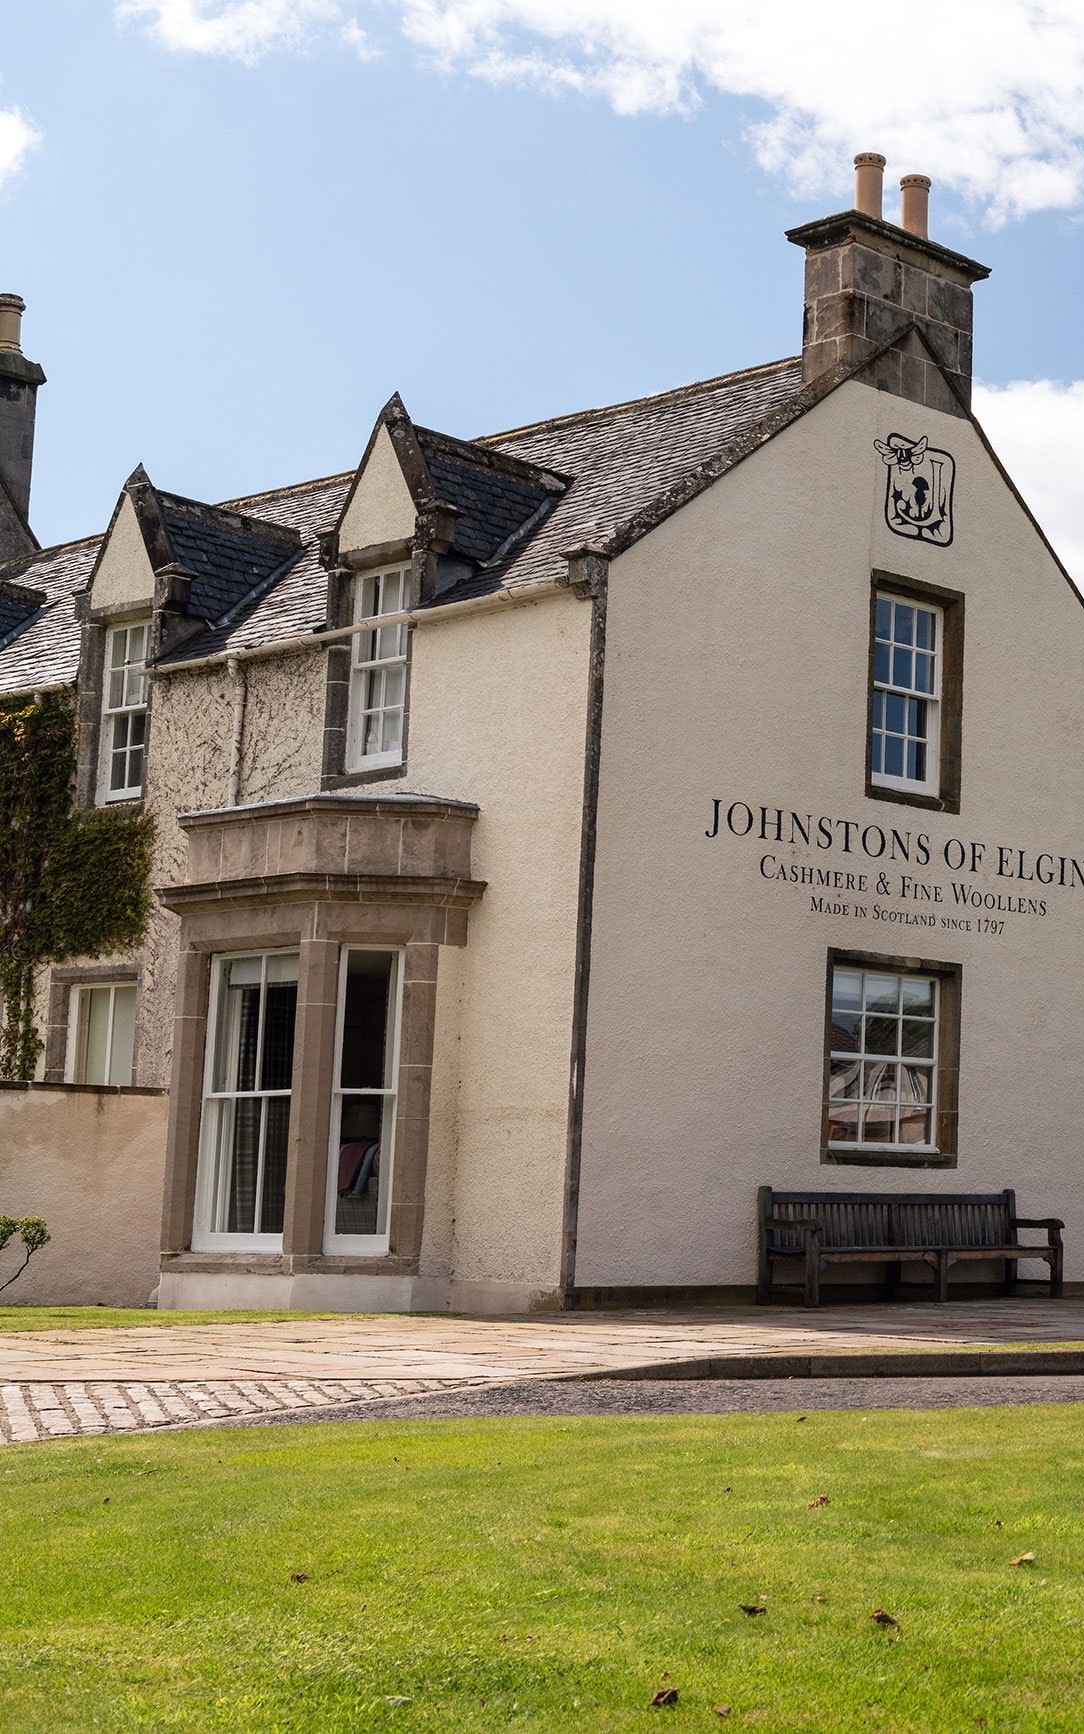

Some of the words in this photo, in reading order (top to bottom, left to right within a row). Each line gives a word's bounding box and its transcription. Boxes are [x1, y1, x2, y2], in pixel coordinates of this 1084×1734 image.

[705, 798, 931, 867] JOHNSTONS
[943, 838, 986, 873] OF
[760, 854, 869, 892] CASHMERE
[876, 871, 891, 896] &
[900, 875, 944, 903] FINE
[951, 882, 1048, 917] WOOLLENS
[810, 896, 850, 917] MADE
[854, 906, 868, 919] IN
[872, 904, 936, 927] SCOTLAND
[940, 917, 972, 932] SINCE
[977, 918, 1005, 935] 1797
